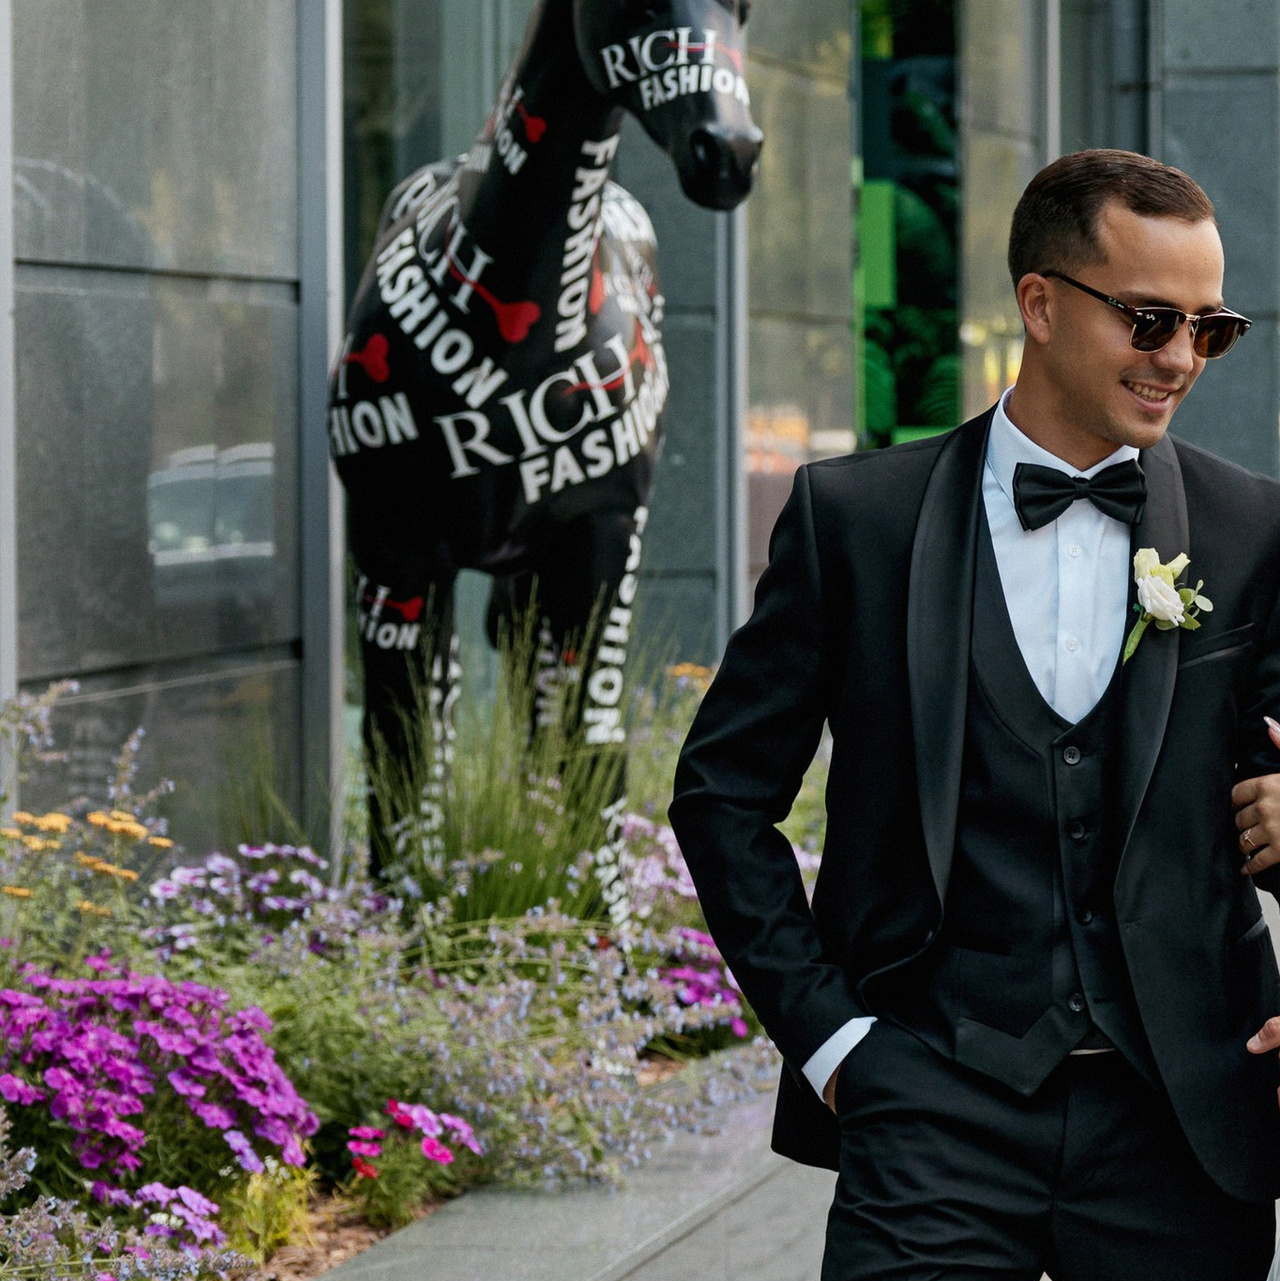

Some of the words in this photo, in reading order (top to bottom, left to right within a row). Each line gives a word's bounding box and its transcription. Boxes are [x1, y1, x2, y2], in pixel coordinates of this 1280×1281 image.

[601, 26, 717, 89] RICH
[639, 64, 751, 111] FASHION
[376, 226, 509, 410] FASHION
[554, 135, 620, 353] FASHION
[432, 333, 636, 480] RICH
[518, 352, 670, 505] FASHION
